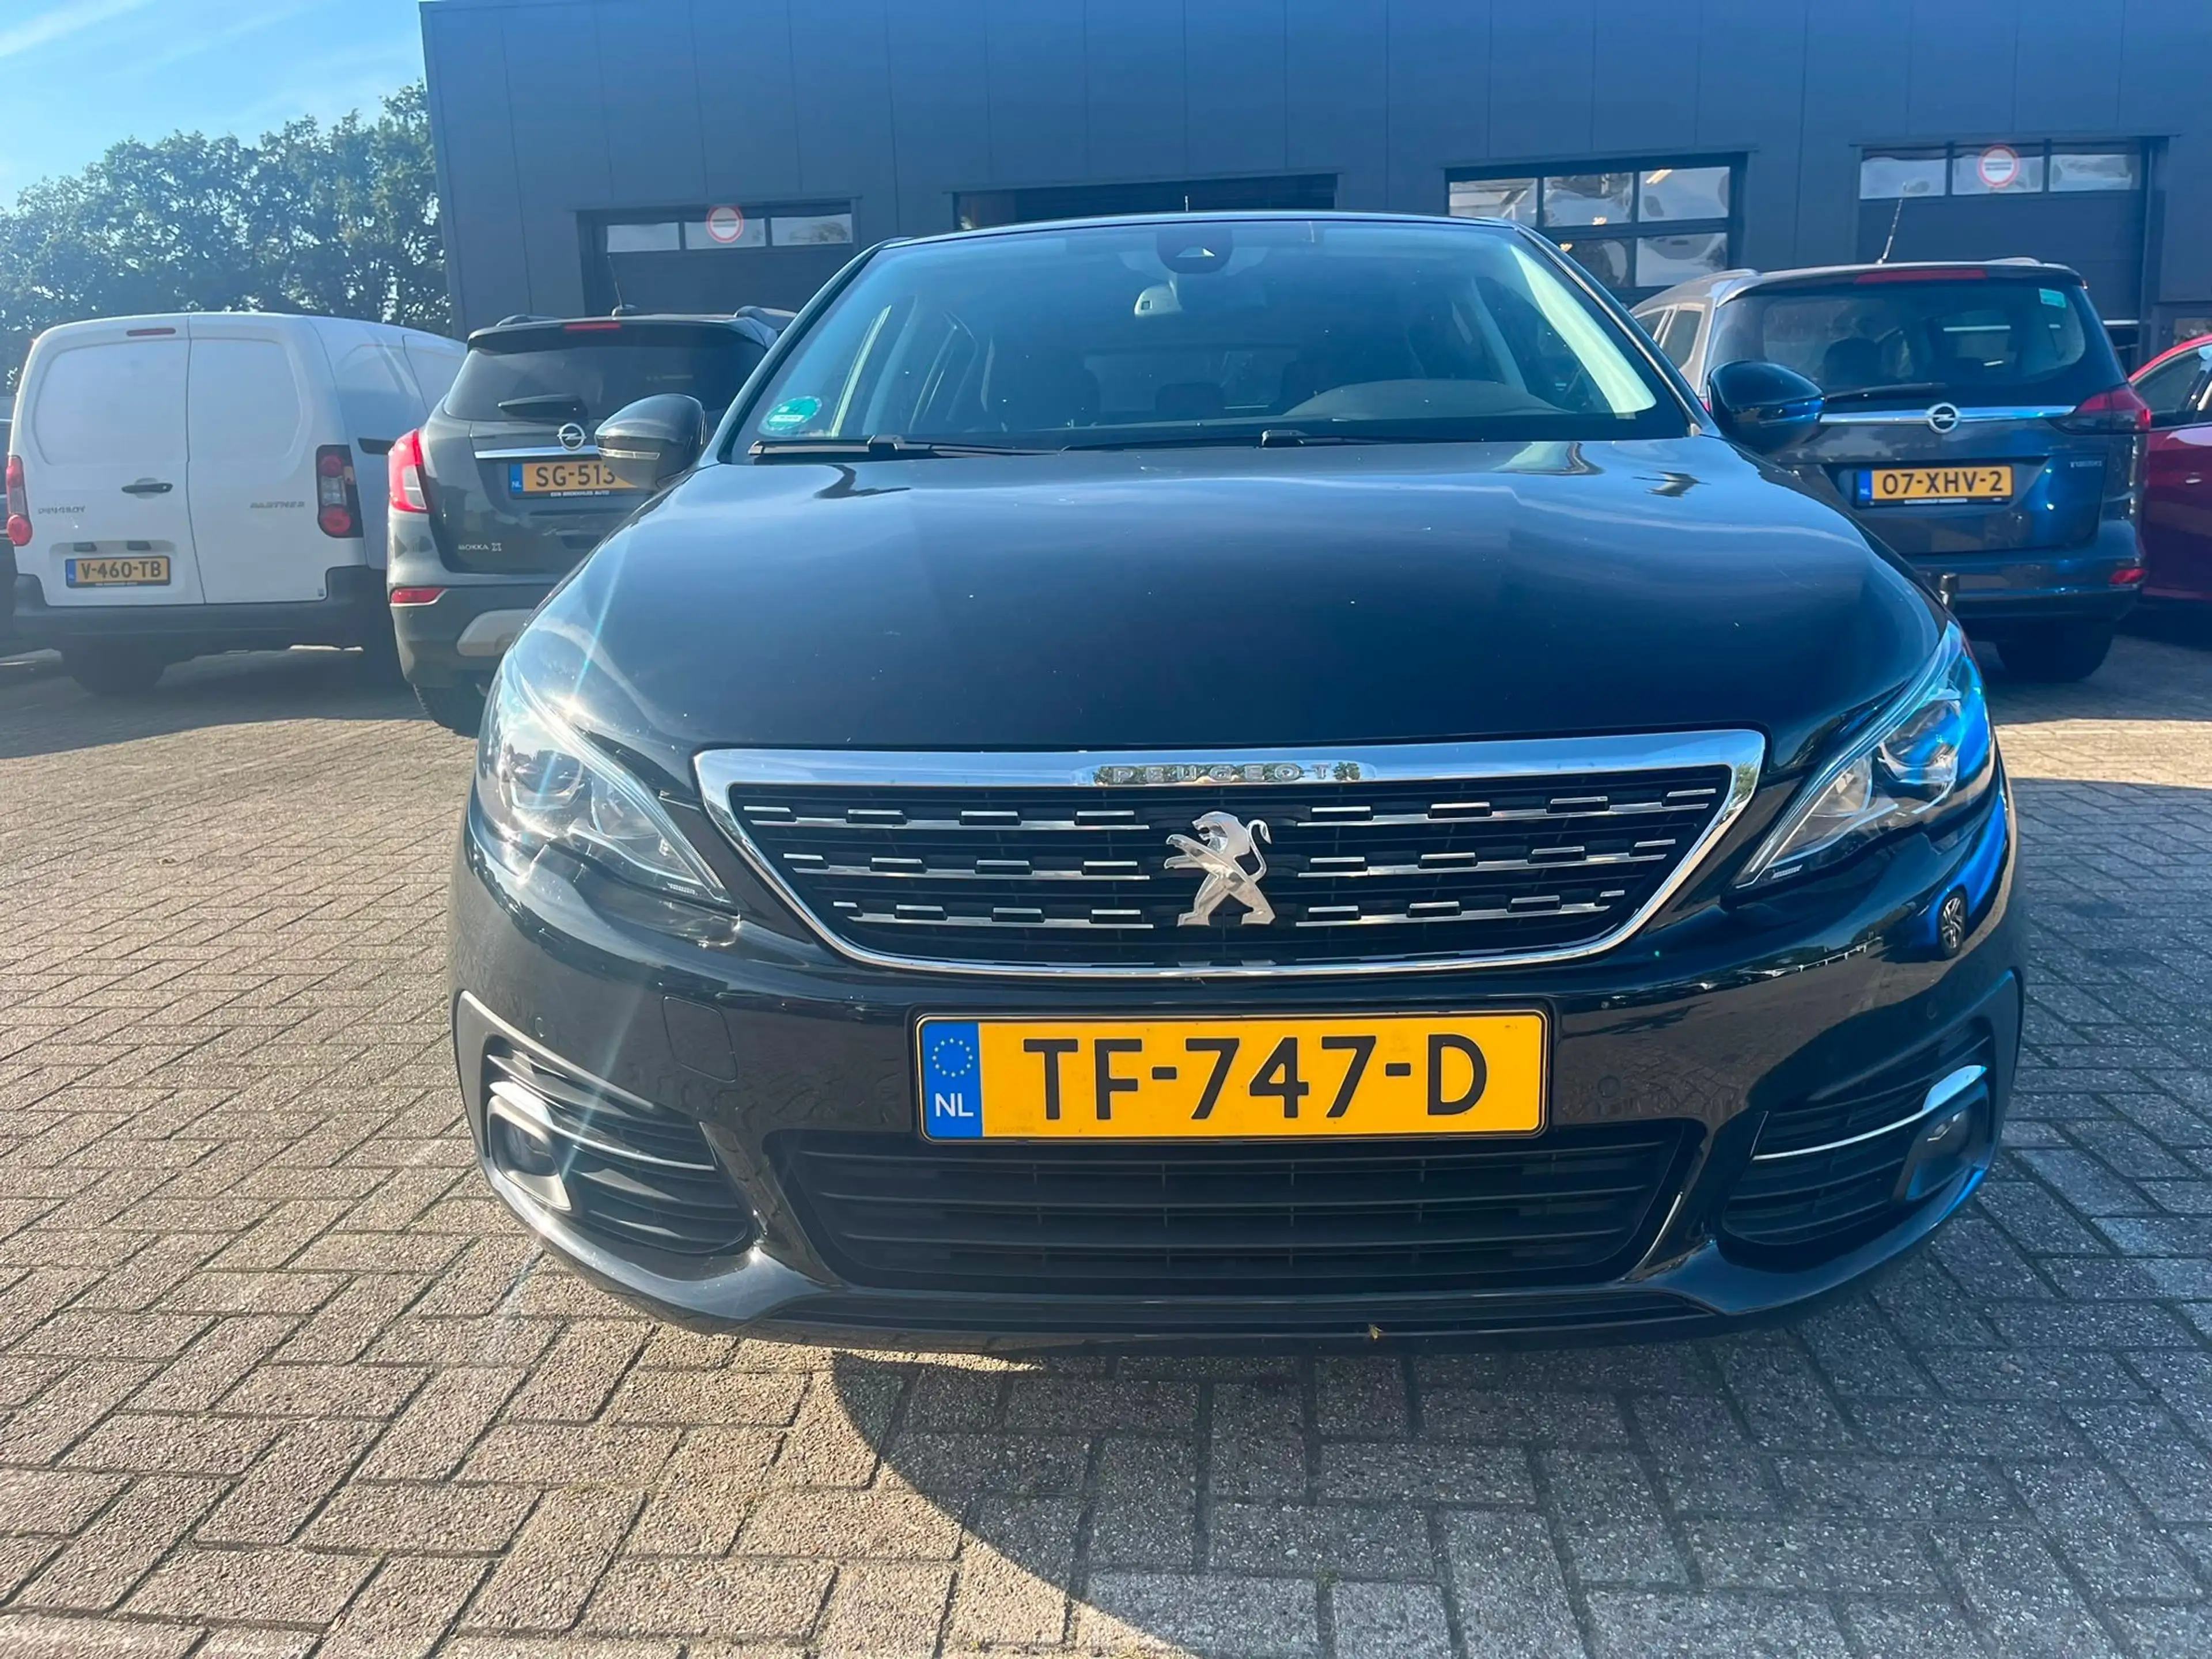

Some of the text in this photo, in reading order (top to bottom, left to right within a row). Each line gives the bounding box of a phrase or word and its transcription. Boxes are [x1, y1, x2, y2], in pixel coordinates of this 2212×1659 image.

[1882, 470, 2003, 495] 07-XHV-2
[80, 560, 162, 579] V-460-TB
[1112, 763, 1332, 783] PEUGEOT
[1023, 1033, 1487, 1120] TF-747-D
[934, 1092, 974, 1118] NL
